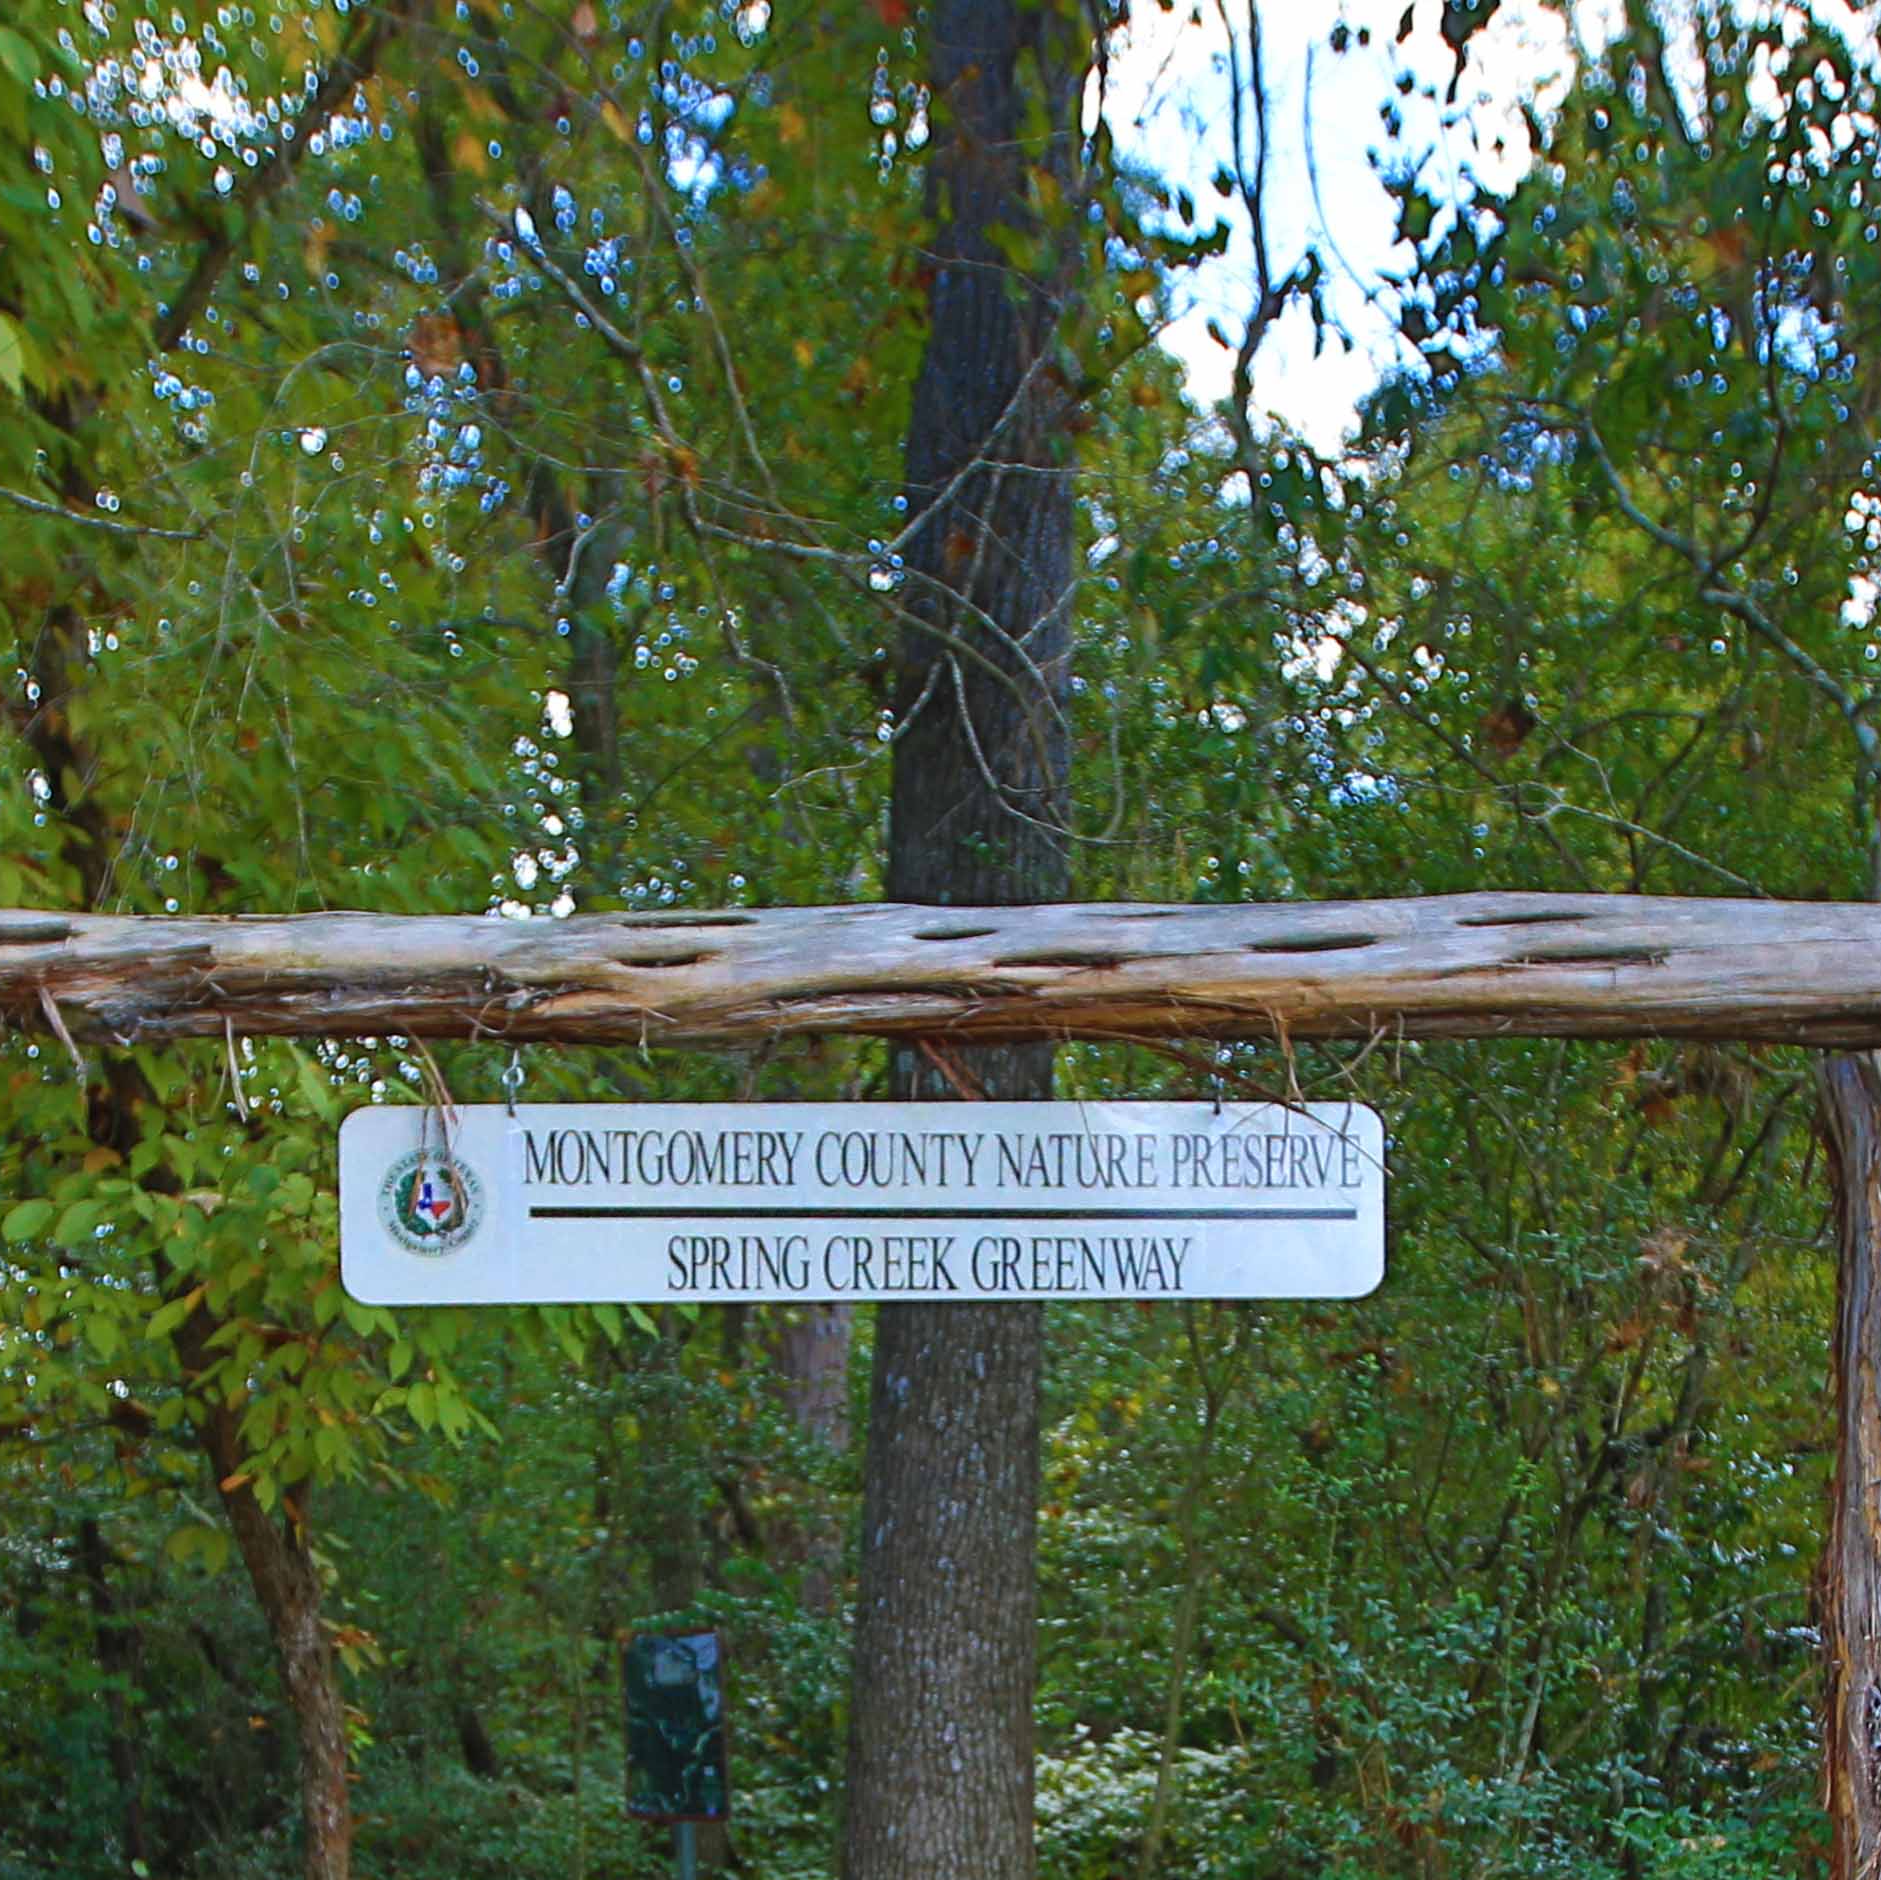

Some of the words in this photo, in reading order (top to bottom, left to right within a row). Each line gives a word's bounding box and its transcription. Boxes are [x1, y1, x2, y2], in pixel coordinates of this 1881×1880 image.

[523, 1129, 804, 1186] MONTGOMERY
[815, 1131, 984, 1188] COUNTY
[996, 1133, 1158, 1189] NATURE
[1168, 1134, 1363, 1188] PRESERVE
[666, 1235, 811, 1291] SPRING
[823, 1236, 958, 1291] CREEK
[971, 1236, 1192, 1291] GREENWAY
